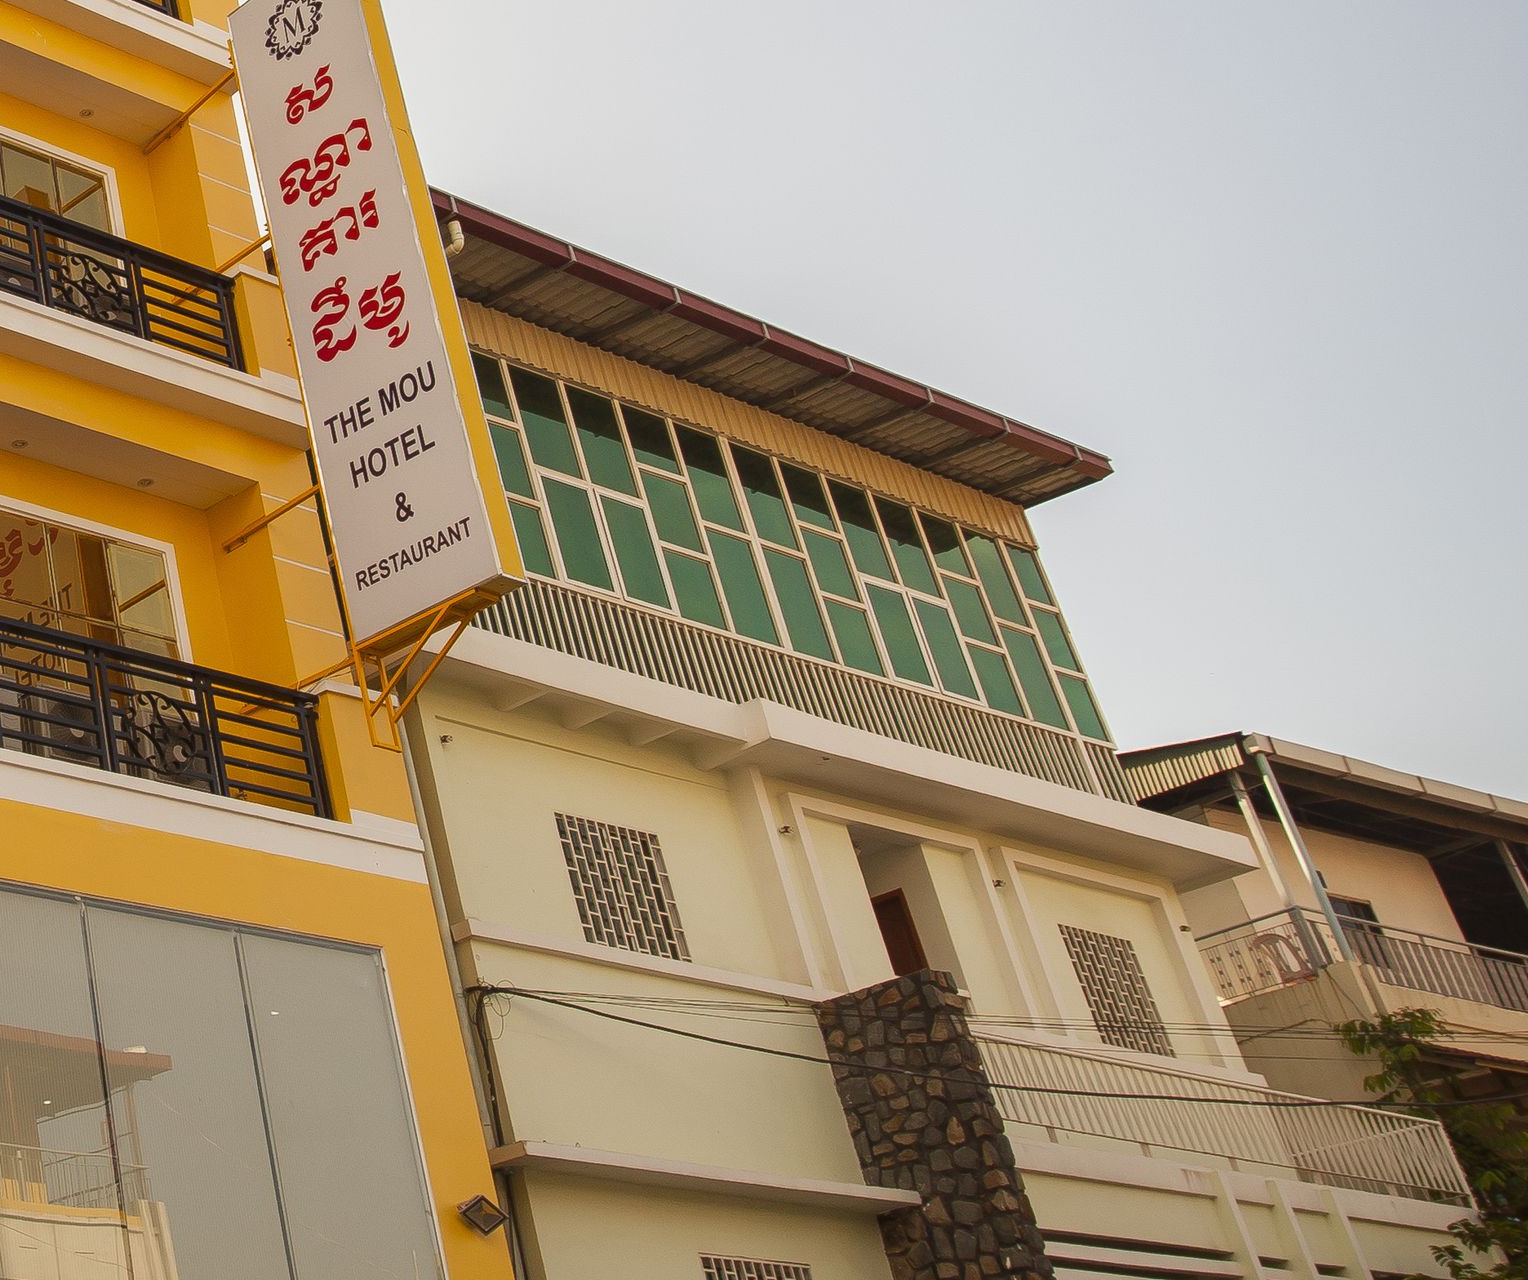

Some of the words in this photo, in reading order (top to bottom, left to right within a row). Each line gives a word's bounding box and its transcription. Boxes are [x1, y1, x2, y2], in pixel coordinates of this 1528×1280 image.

[282, 6, 306, 43] M
[323, 396, 375, 445] THE
[378, 360, 436, 416] MOU
[349, 424, 436, 489] HOTEL
[395, 491, 415, 522] &
[355, 517, 471, 591] RESTAURANT
